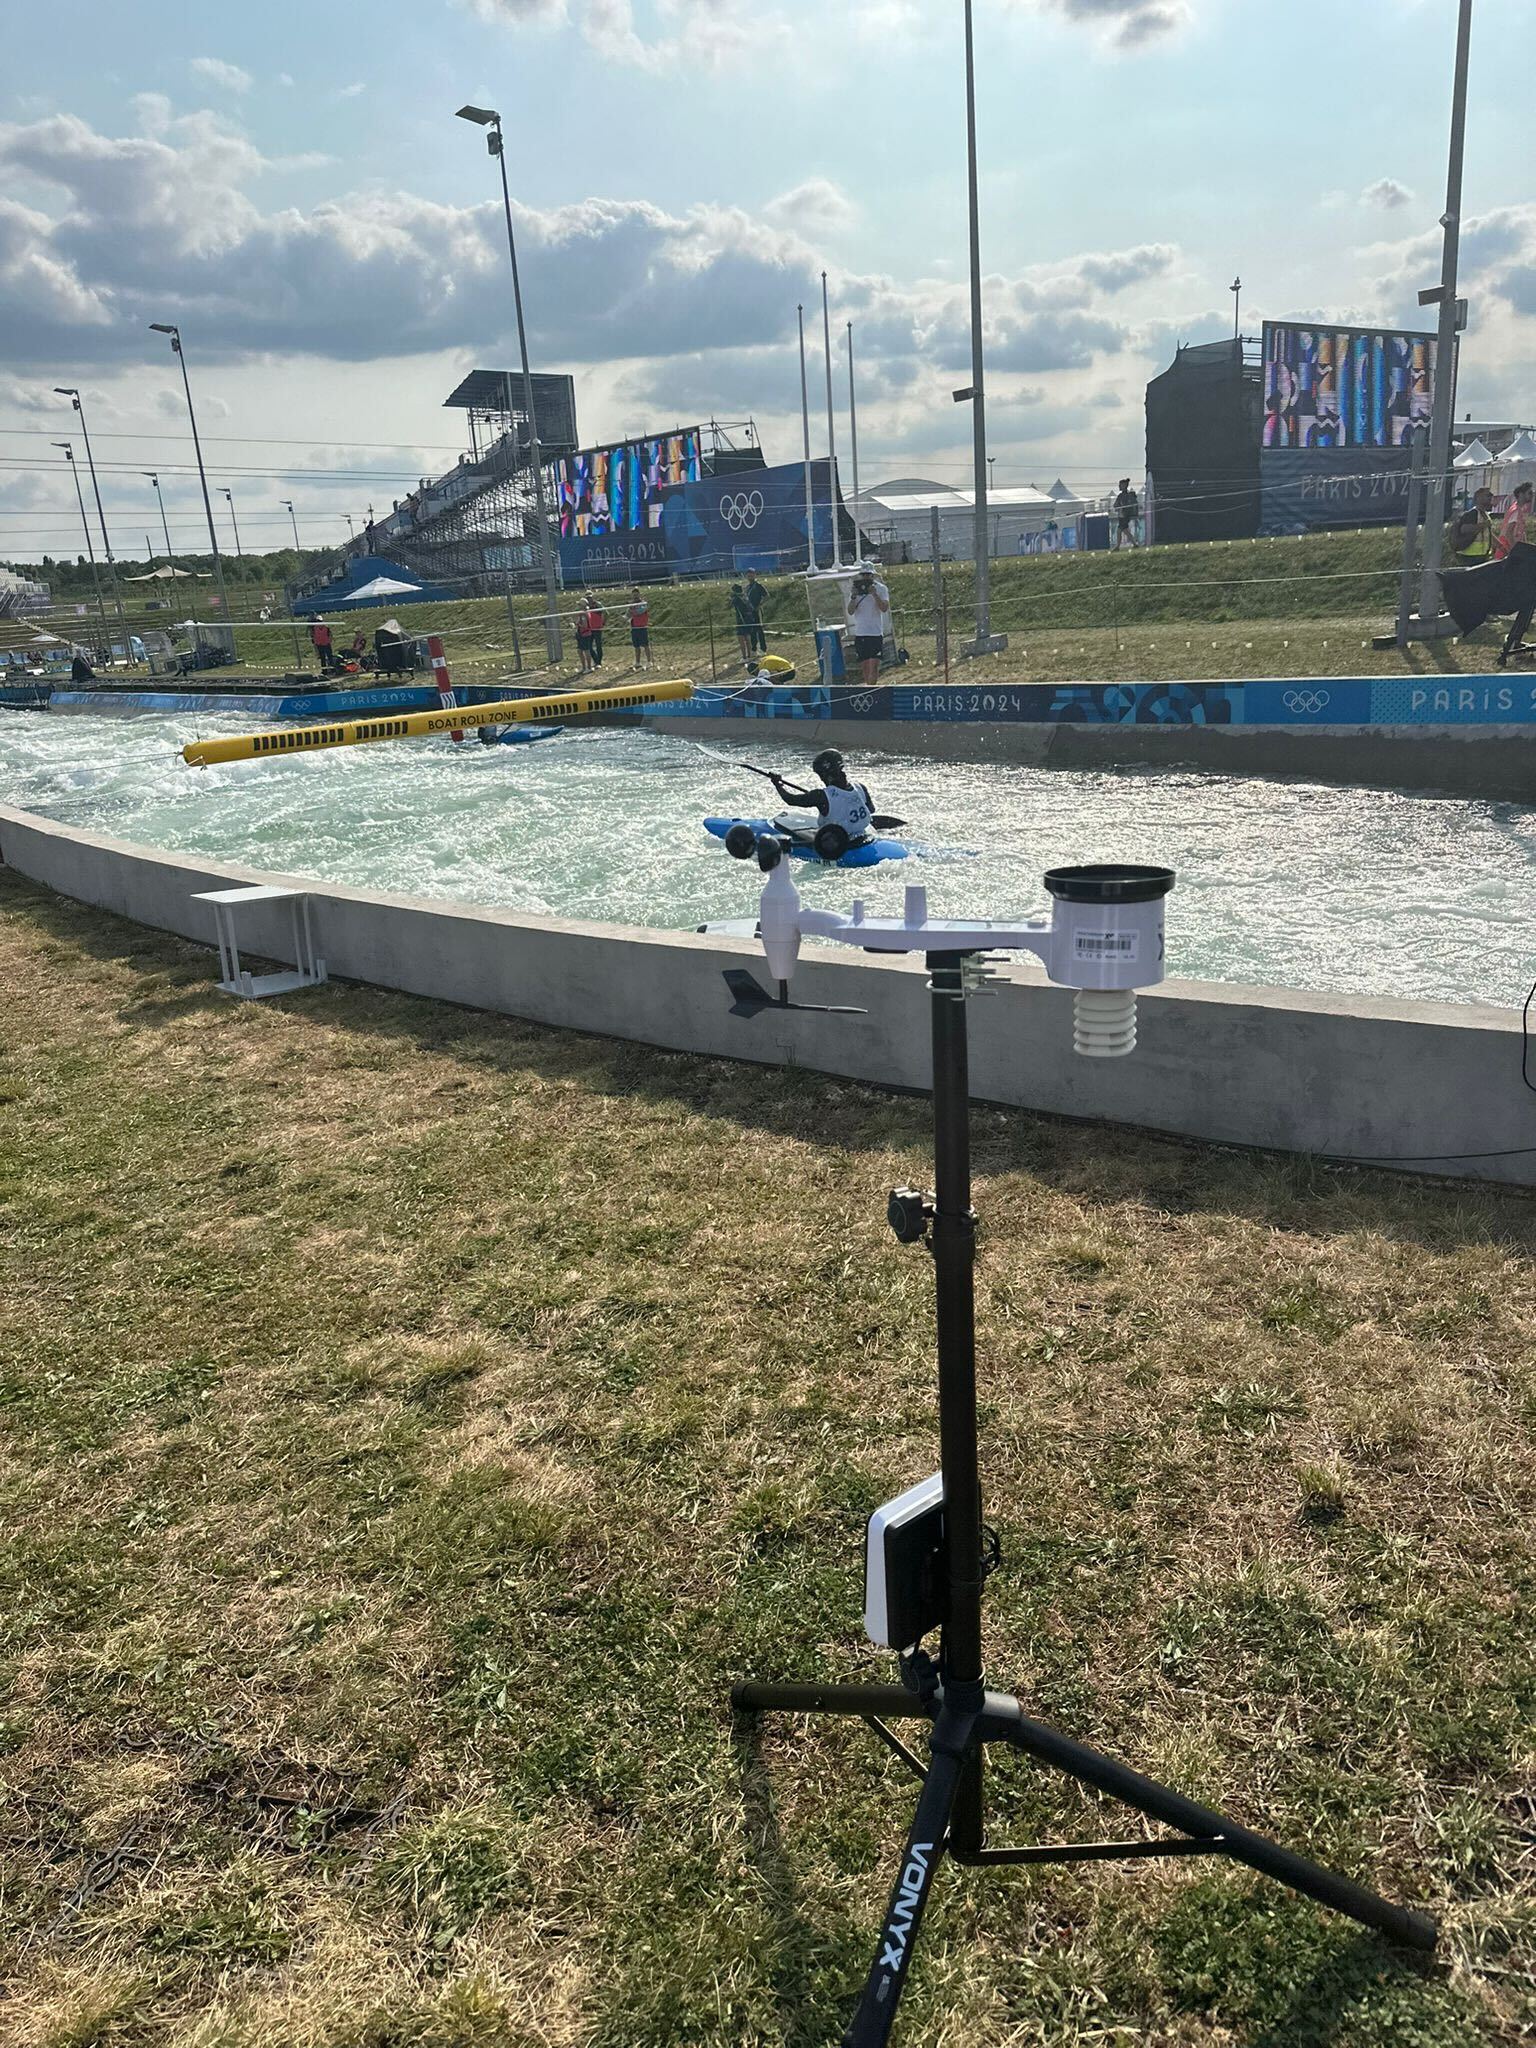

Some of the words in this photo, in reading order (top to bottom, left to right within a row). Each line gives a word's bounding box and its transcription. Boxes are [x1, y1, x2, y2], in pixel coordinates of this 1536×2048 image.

[1369, 474, 1409, 498] 202
[382, 692, 415, 703] 2024
[970, 694, 1021, 712] 2024
[428, 717, 457, 730] BOAT
[461, 714, 487, 726] ROLL
[489, 711, 517, 722] ZONE
[849, 806, 867, 824] 38
[879, 1842, 934, 1972] VONYX
